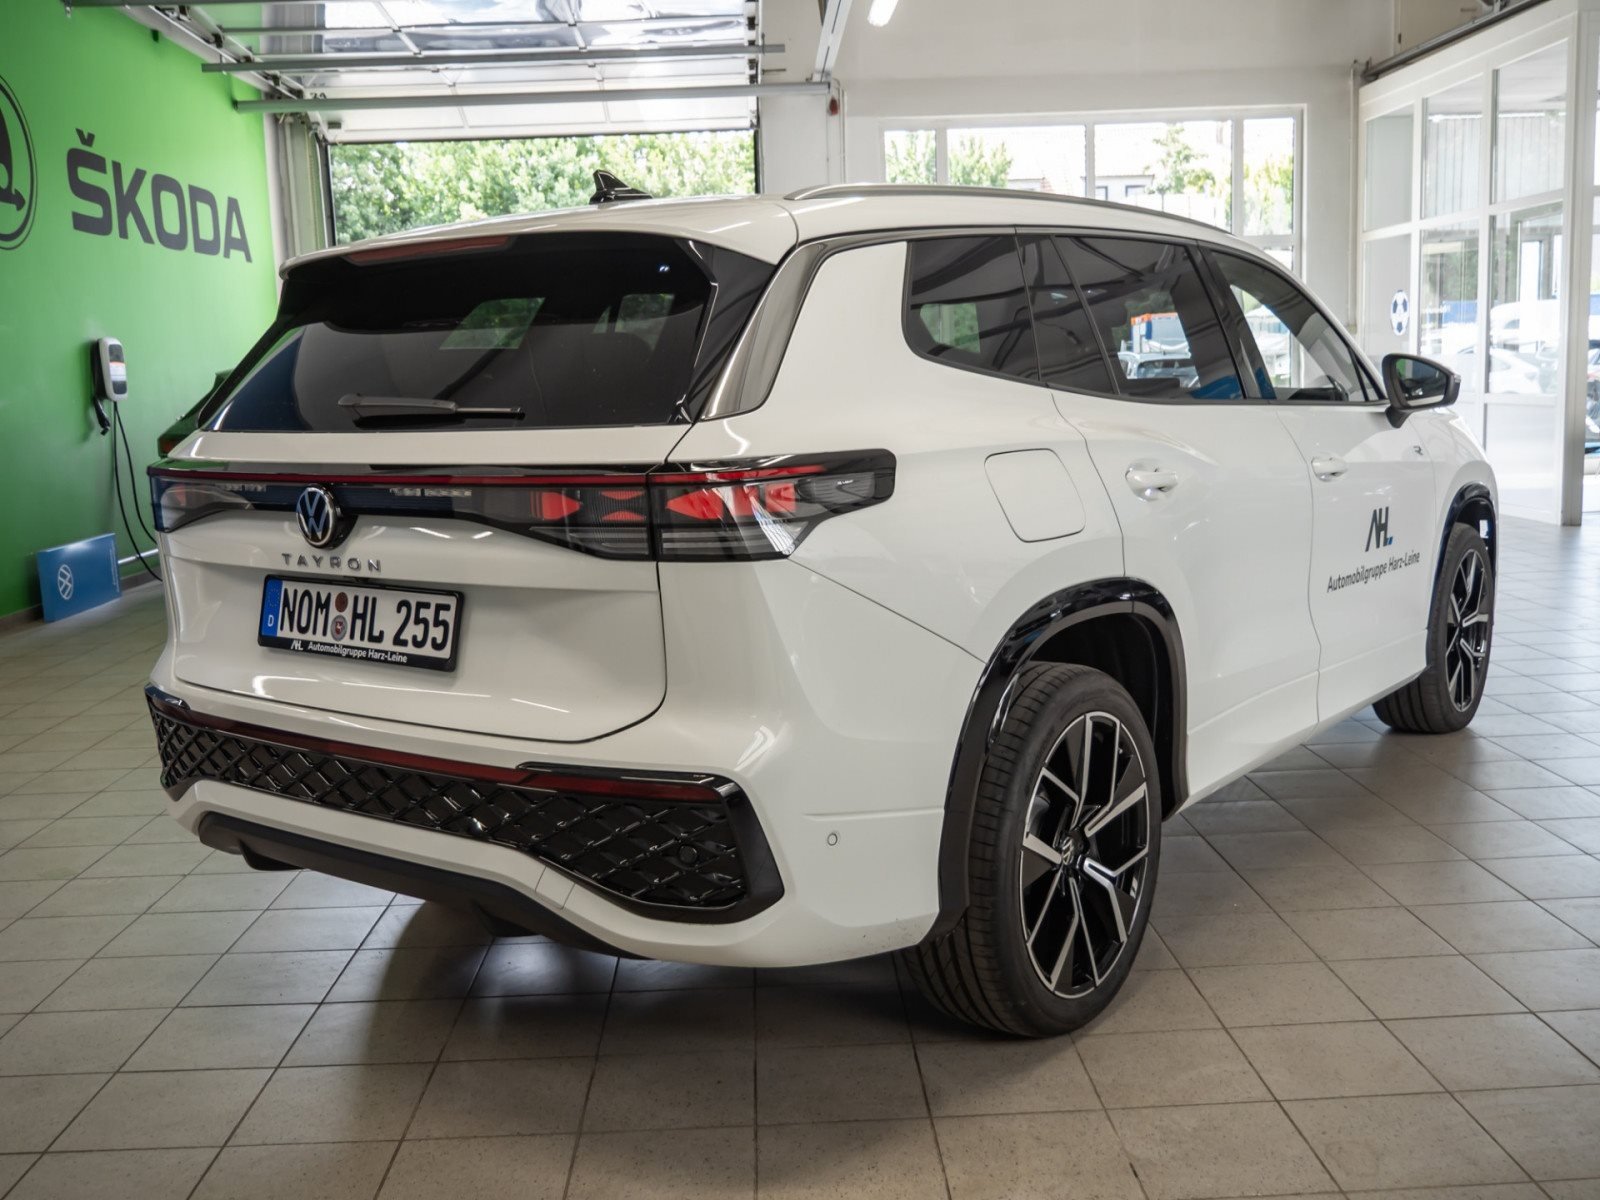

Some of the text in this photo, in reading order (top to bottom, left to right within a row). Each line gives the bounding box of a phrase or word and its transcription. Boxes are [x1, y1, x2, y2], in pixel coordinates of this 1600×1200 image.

[66, 127, 253, 263] ŠKODA
[281, 553, 381, 573] TAYRON
[1327, 550, 1420, 593] Automobilgruppe Harz-Leine
[267, 614, 274, 627] D
[280, 588, 451, 651] NOM HL 255
[308, 642, 367, 658] Automobilgruppe
[368, 648, 407, 663] Harz-Leine
